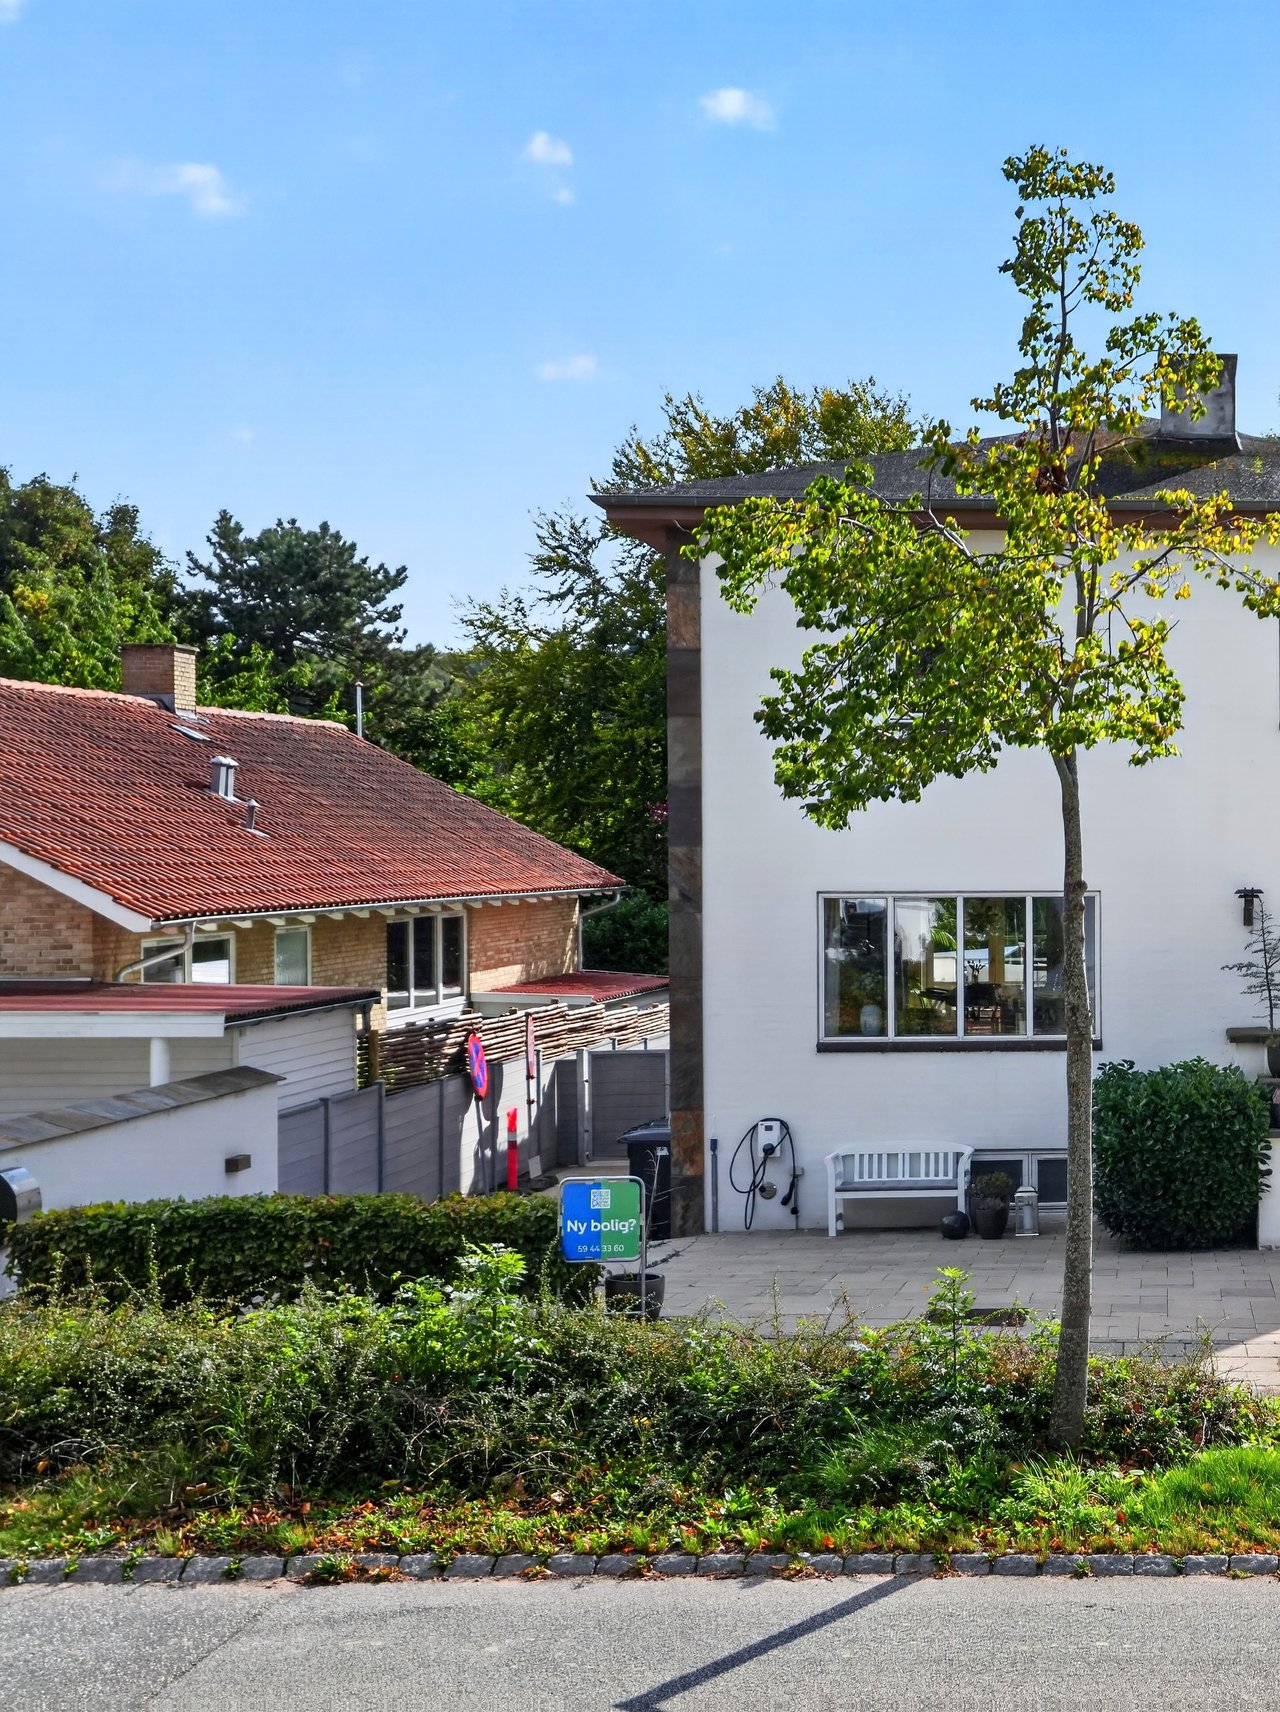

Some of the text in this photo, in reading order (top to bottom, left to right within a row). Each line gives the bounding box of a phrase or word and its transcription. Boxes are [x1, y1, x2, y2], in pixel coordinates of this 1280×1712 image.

[567, 1219, 636, 1234] Ny bolig?
[613, 1244, 624, 1252] 60
